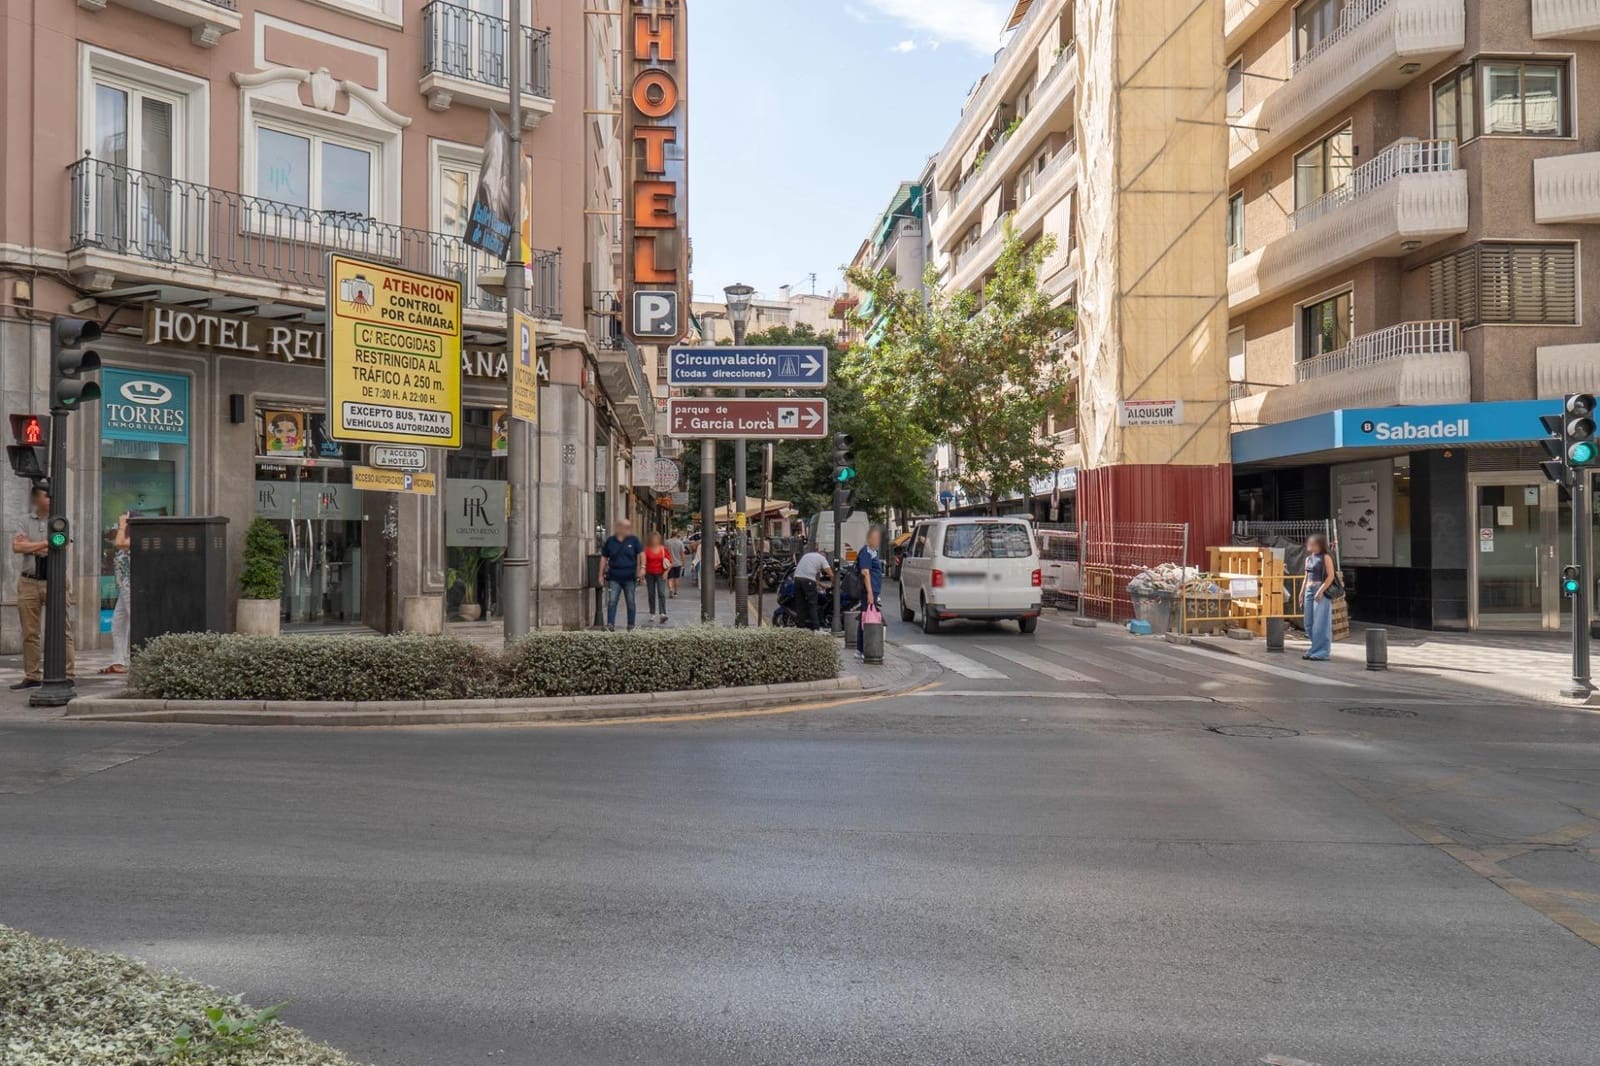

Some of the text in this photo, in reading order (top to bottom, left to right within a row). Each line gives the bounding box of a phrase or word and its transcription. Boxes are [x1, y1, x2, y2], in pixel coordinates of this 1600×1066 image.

[632, 13, 679, 284] HOTEL
[382, 277, 454, 303] ATENCIÓN
[390, 295, 443, 315] CONTROL
[640, 295, 670, 332] P
[381, 307, 454, 331] POR CÁMARA
[146, 307, 260, 352] HOTEL
[376, 331, 436, 353] RECOGIDAS
[355, 349, 441, 373] RESTRINGIDA AL
[675, 353, 776, 366] Circunvalación
[352, 366, 445, 391] TRÁFICO A 250 m.
[675, 368, 772, 379] (todas direcciones)
[362, 386, 374, 397] DE
[375, 387, 391, 400] 7:30
[392, 390, 401, 401] H.
[402, 391, 408, 402] A
[409, 391, 429, 405] 22:00
[106, 404, 184, 427] TORRES
[350, 406, 446, 423] EXCEPTO BUS, TAXI Y
[675, 406, 728, 415] parque de
[107, 421, 183, 432] INMOBILIARIA
[346, 418, 450, 435] VEHÍCULOS AUTORIZADOS
[675, 418, 688, 429] F.
[1375, 419, 1469, 440] Sabadell
[389, 450, 418, 458] ACCESO
